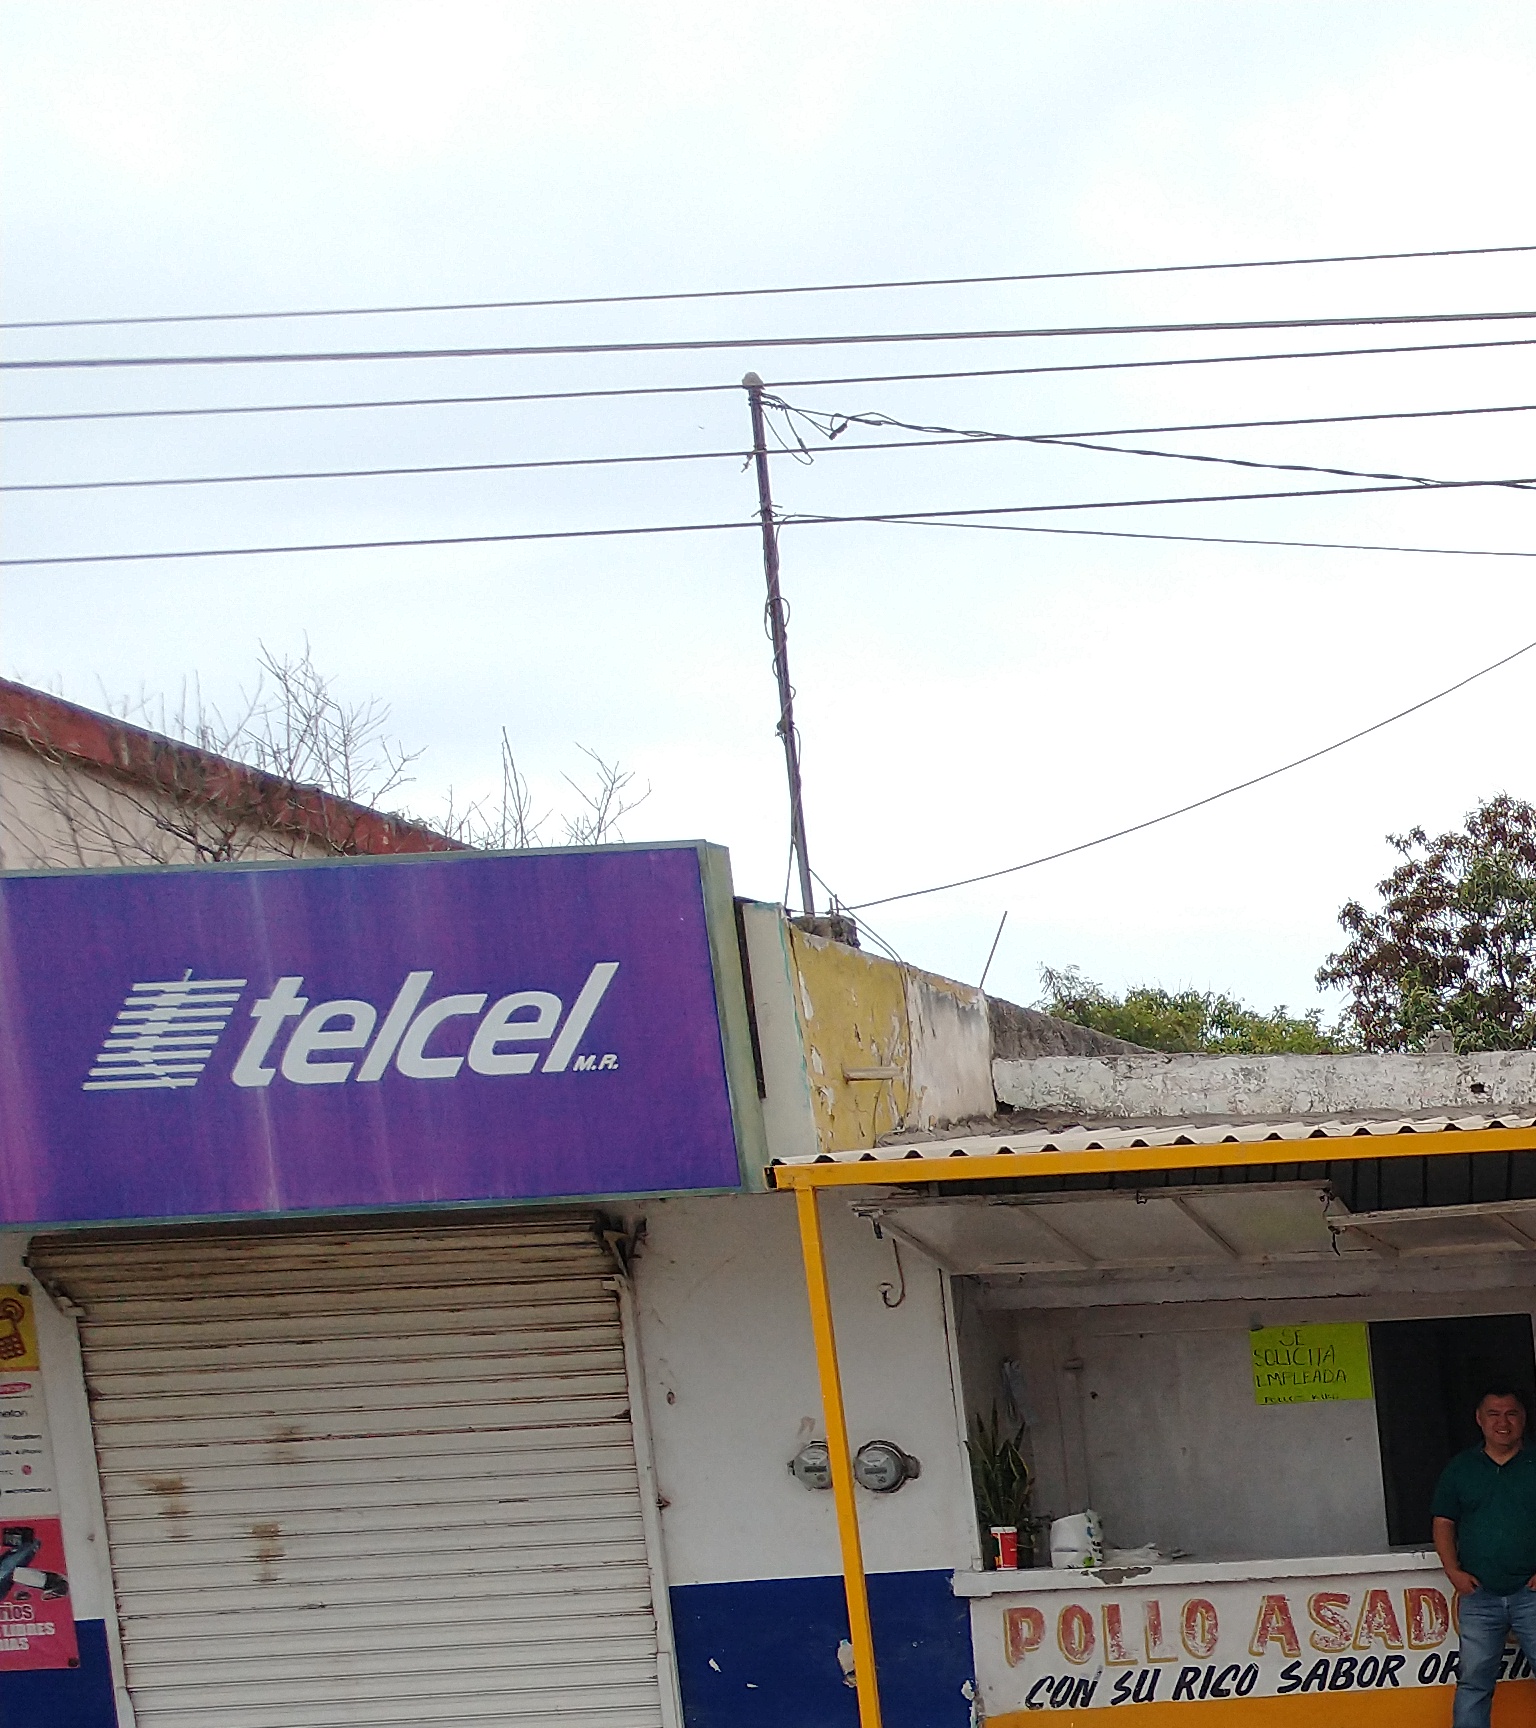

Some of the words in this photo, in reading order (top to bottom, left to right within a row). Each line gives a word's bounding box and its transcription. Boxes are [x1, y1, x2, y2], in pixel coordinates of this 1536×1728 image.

[231, 961, 620, 1088] telcel
[573, 1054, 619, 1071] M.R.
[1253, 1344, 1335, 1367] SOLICITA
[1279, 1328, 1305, 1346] SE
[1256, 1369, 1347, 1387] EMPLEADA
[1003, 1597, 1220, 1668] POLLO
[1248, 1587, 1460, 1658] ASAD
[1024, 1672, 1099, 1711] CON
[1111, 1668, 1162, 1706] SU
[1173, 1662, 1260, 1701] RICO
[1277, 1653, 1407, 1694] SABOR
